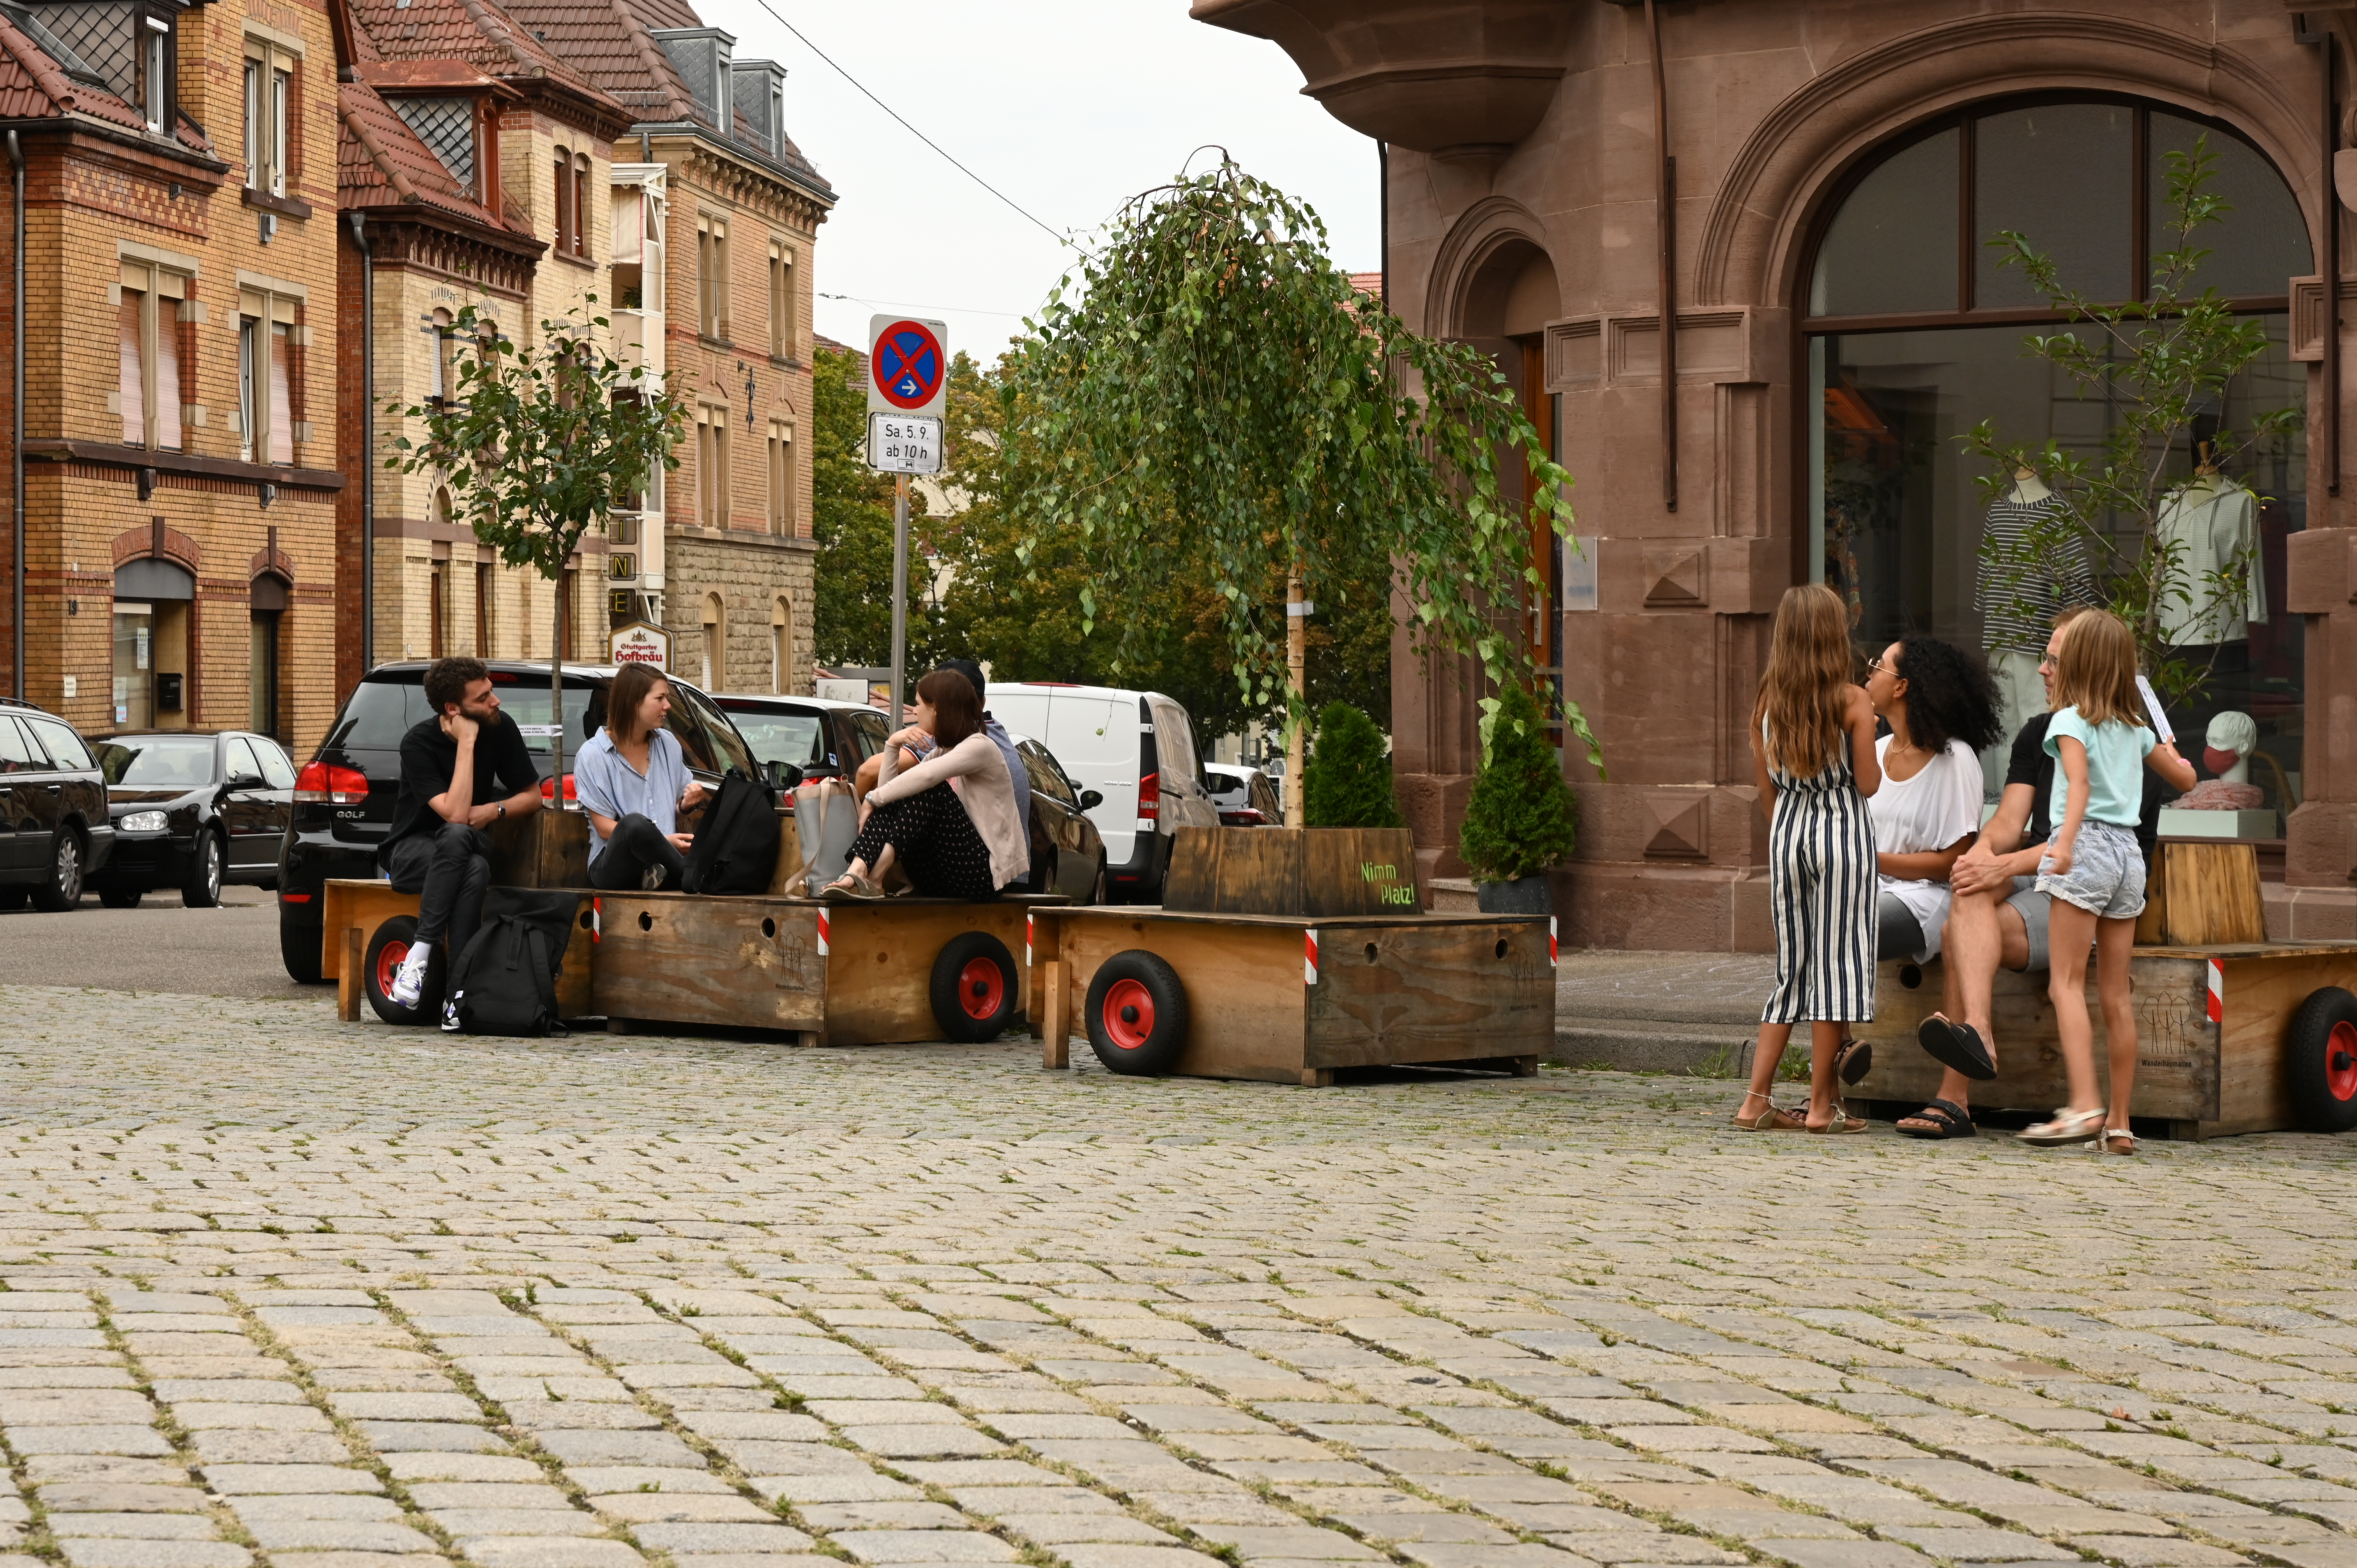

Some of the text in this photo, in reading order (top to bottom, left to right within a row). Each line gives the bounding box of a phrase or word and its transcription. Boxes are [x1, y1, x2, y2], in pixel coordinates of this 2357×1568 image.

[885, 424, 929, 440] Sa, 5. 9.
[887, 445, 927, 459] ab 10 h
[68, 599, 78, 616] 19
[615, 650, 663, 662] Hofbräu
[1361, 862, 1396, 882] Nimm
[1381, 883, 1414, 904] Platz!
